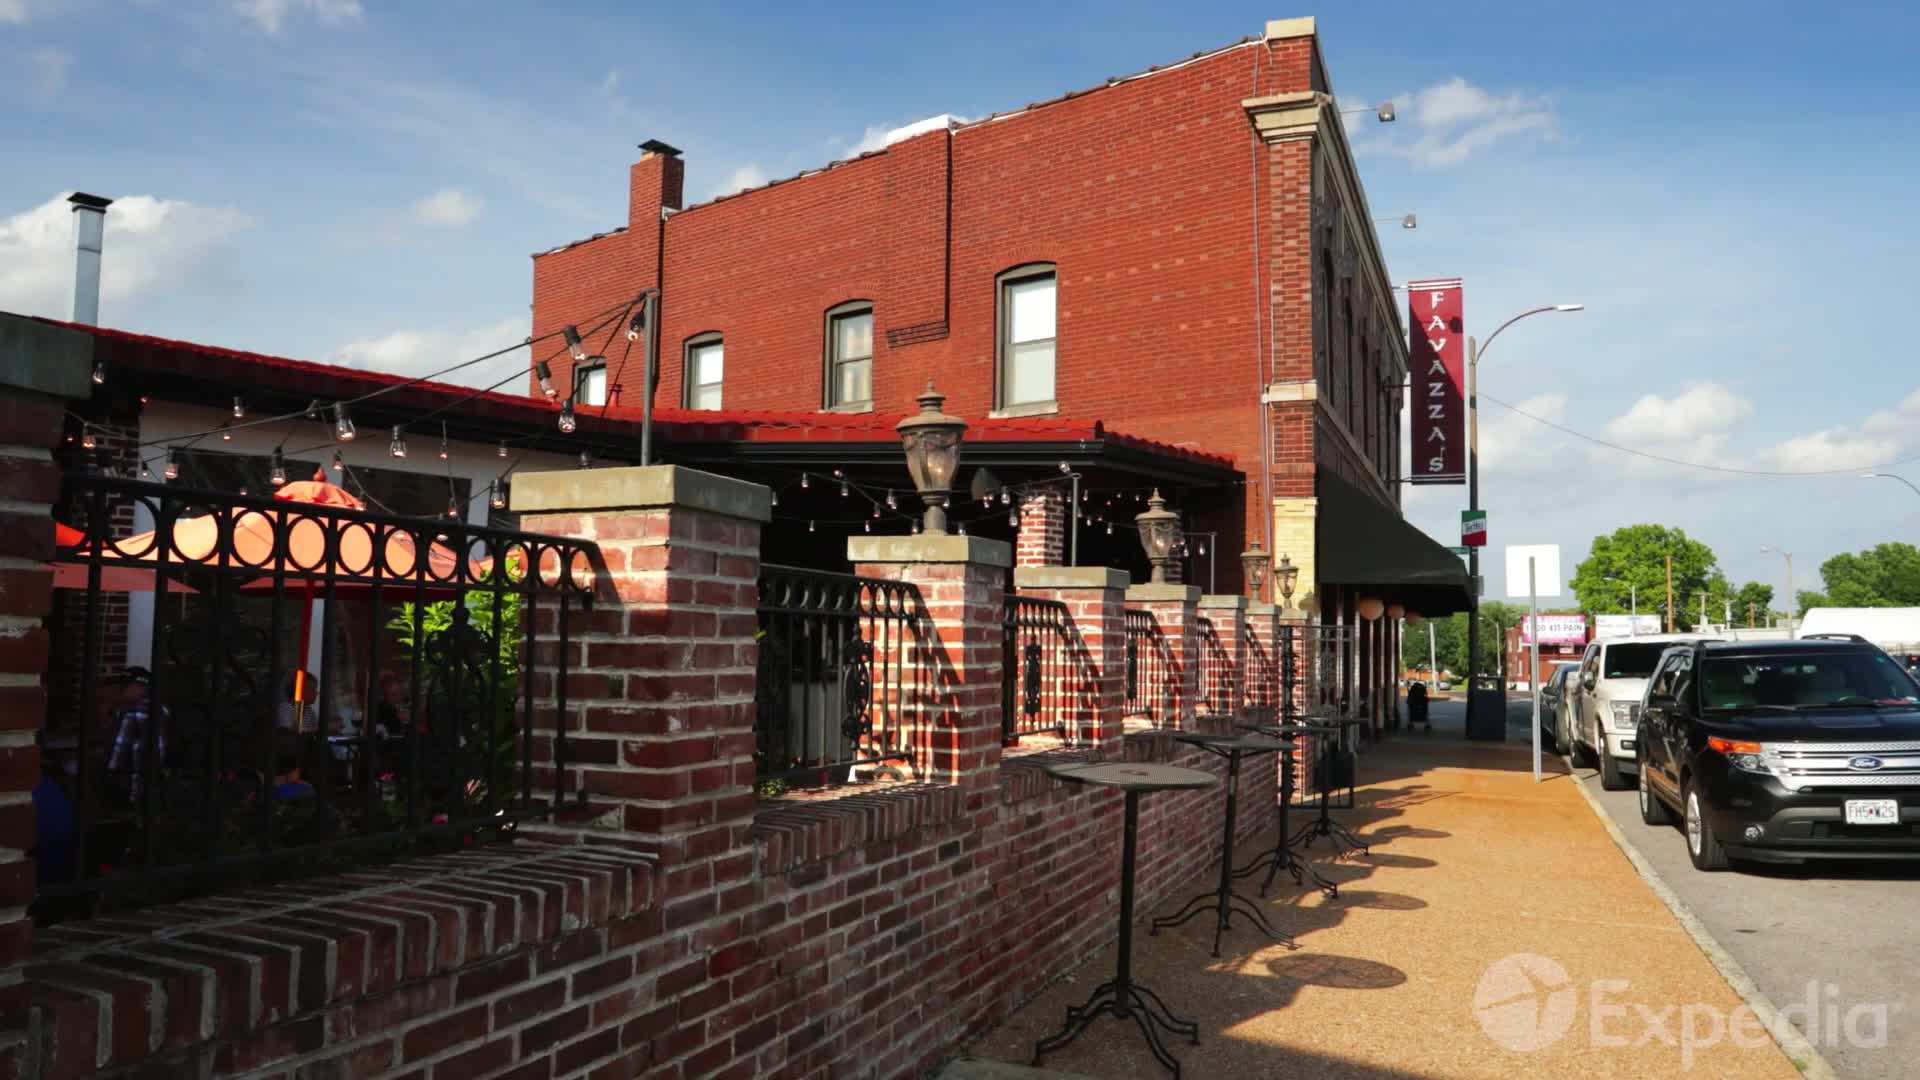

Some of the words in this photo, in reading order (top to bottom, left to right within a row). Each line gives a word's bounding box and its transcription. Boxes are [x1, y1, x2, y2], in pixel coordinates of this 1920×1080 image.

[1427, 291, 1447, 473] FAVAZZA'S
[1563, 624, 1583, 632] PAIN
[1854, 758, 1876, 767] Ford
